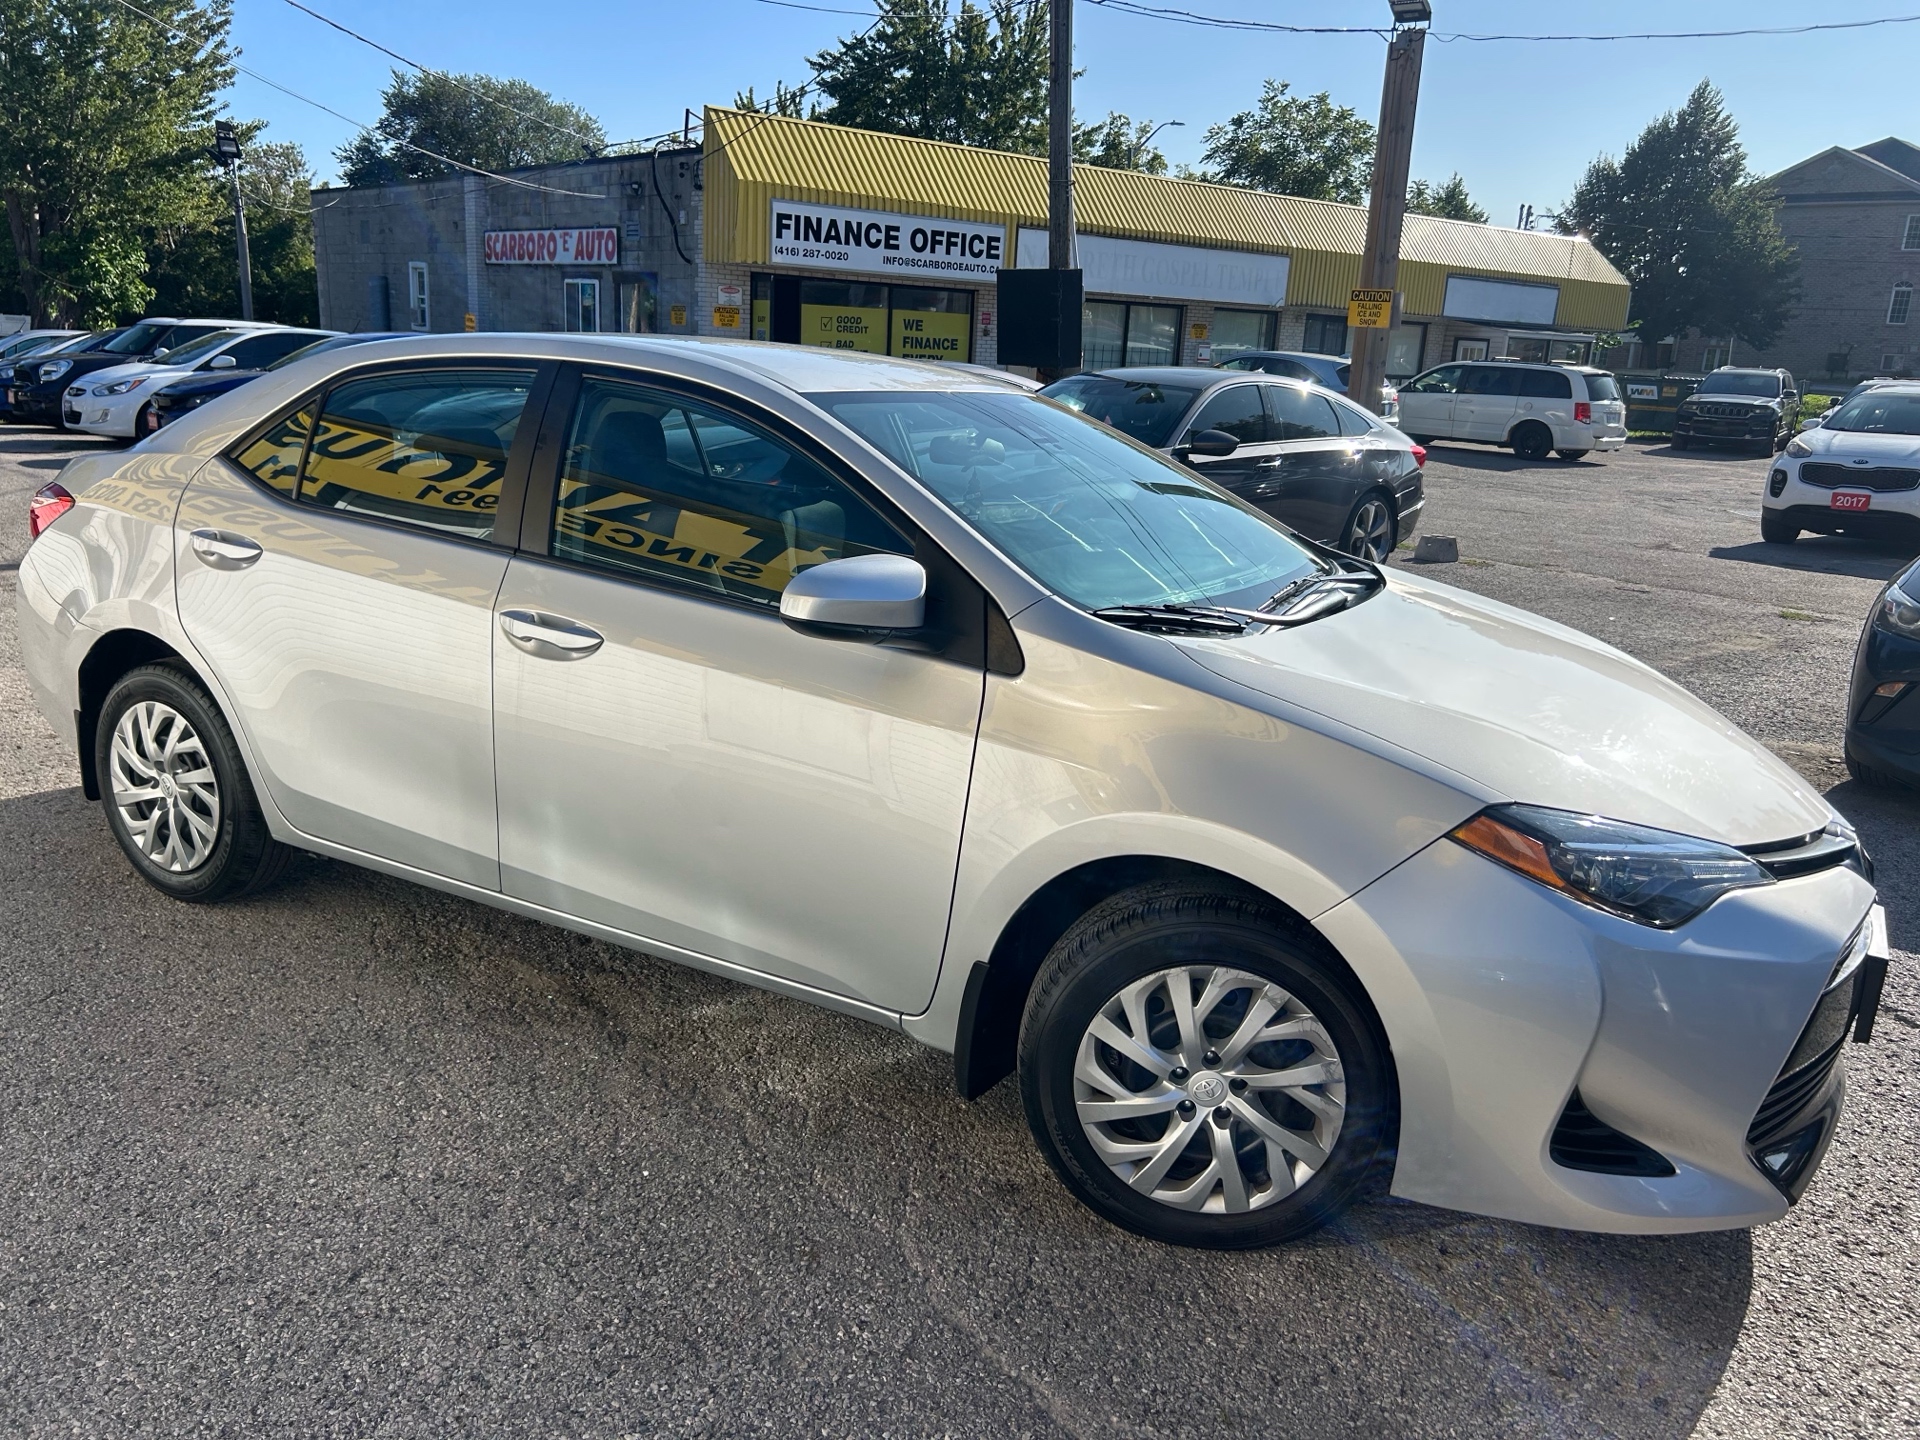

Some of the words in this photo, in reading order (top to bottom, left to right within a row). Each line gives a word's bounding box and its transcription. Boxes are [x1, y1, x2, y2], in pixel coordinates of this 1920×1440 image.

[776, 212, 900, 250] FINANCE
[910, 227, 1001, 260] OFFICE
[486, 232, 557, 261] SCARBORO
[574, 230, 616, 261] AUTO
[774, 245, 799, 256] (416)
[802, 249, 849, 261] 287-0020
[883, 255, 1000, 274] INFO@SCARBOROEAUTO.CA
[1141, 250, 1212, 288] GOSPEL
[1352, 291, 1390, 302] CAUTION
[836, 315, 862, 325] GOOD
[902, 318, 923, 332] WE
[836, 325, 869, 334] CREDIT
[835, 339, 854, 348] BAD
[902, 335, 959, 351] FINANCE
[1631, 388, 1655, 396] WM
[1836, 496, 1866, 507] 2017
